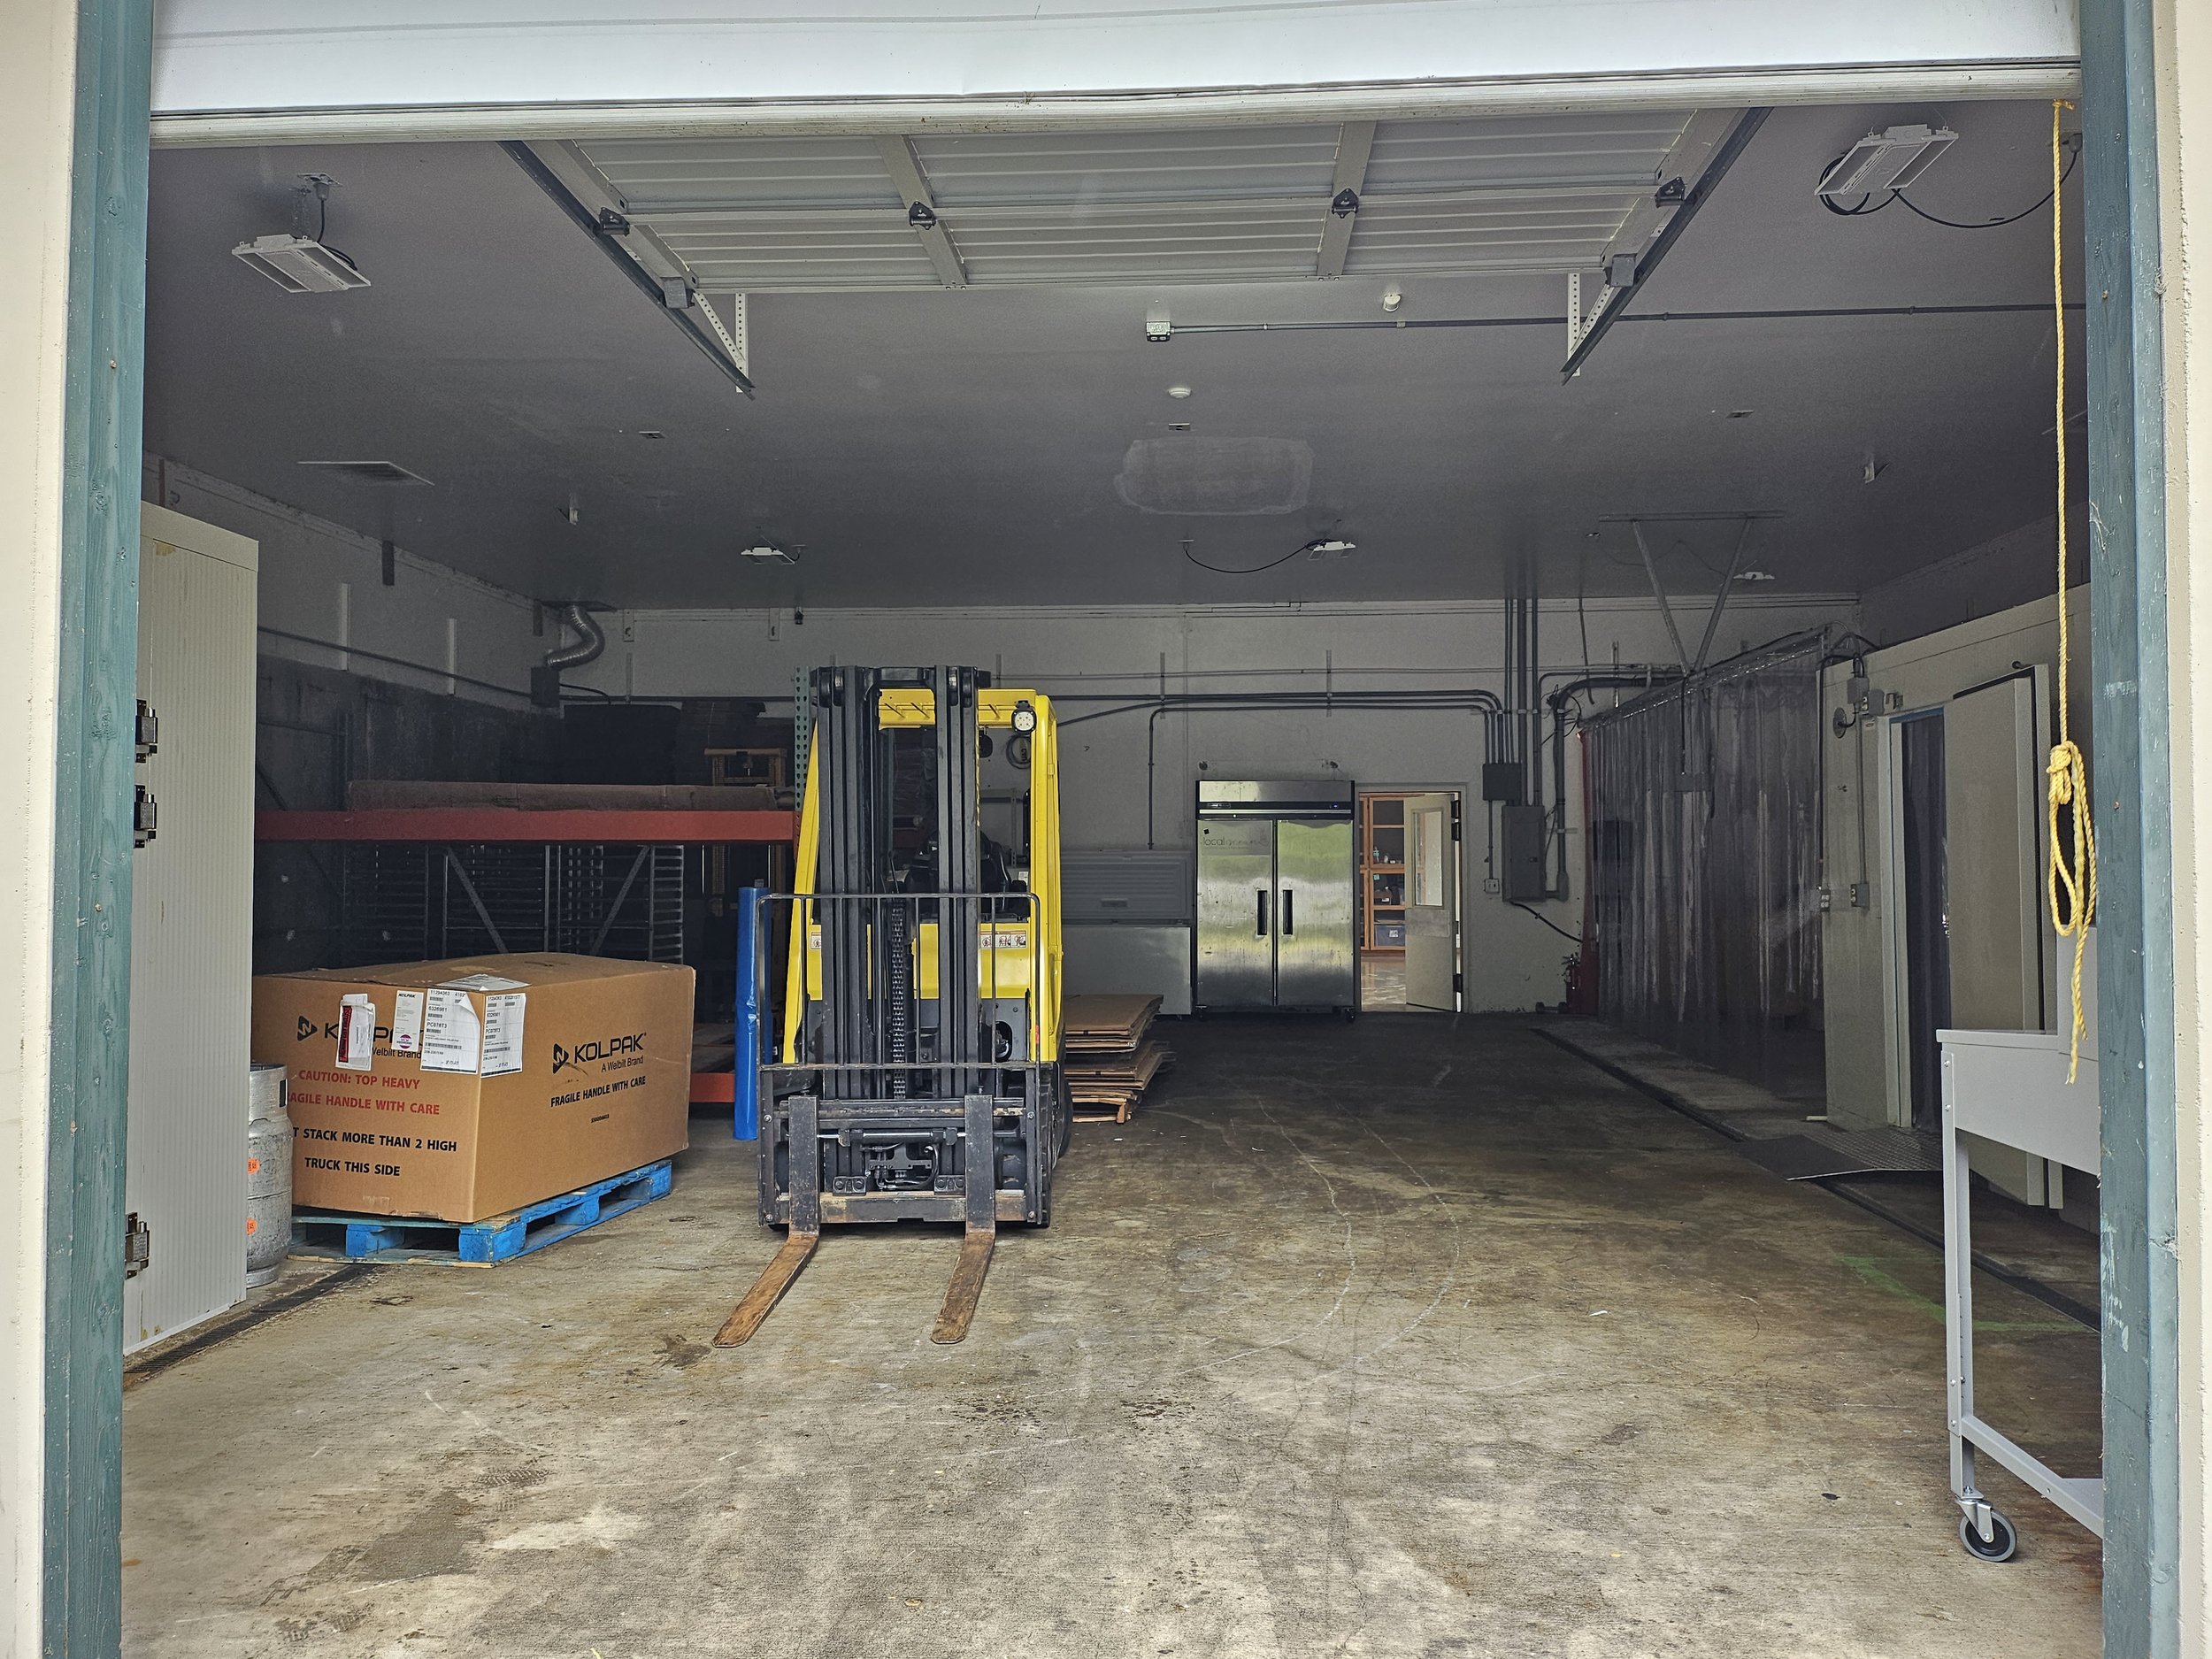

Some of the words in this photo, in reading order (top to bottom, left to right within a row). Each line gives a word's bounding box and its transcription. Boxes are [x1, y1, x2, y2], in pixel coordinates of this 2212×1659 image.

[574, 1033, 644, 1064] KOLPAK
[602, 1063, 607, 1072] A
[608, 1058, 626, 1071] Welbilt
[627, 1056, 644, 1067] Brand
[299, 1070, 351, 1084] CAUTION:
[356, 1075, 378, 1086] TOP
[382, 1077, 420, 1089] HEAVY
[288, 1092, 322, 1104] AGILE
[326, 1095, 372, 1109] HANDLE
[375, 1100, 405, 1112] WITH
[411, 1102, 440, 1115] CARE
[550, 1092, 580, 1108] FRAGILE
[583, 1085, 611, 1100] HANDLE
[612, 1079, 628, 1092] WITH
[630, 1076, 646, 1087] CARE
[303, 1128, 337, 1141] STACK
[342, 1132, 375, 1145] MORE
[379, 1135, 411, 1148] THAN
[415, 1139, 422, 1148] 2
[427, 1140, 457, 1151] HIGH
[304, 1157, 341, 1171] TRUCK
[344, 1161, 370, 1173] THIS
[374, 1164, 401, 1176] SIDE
